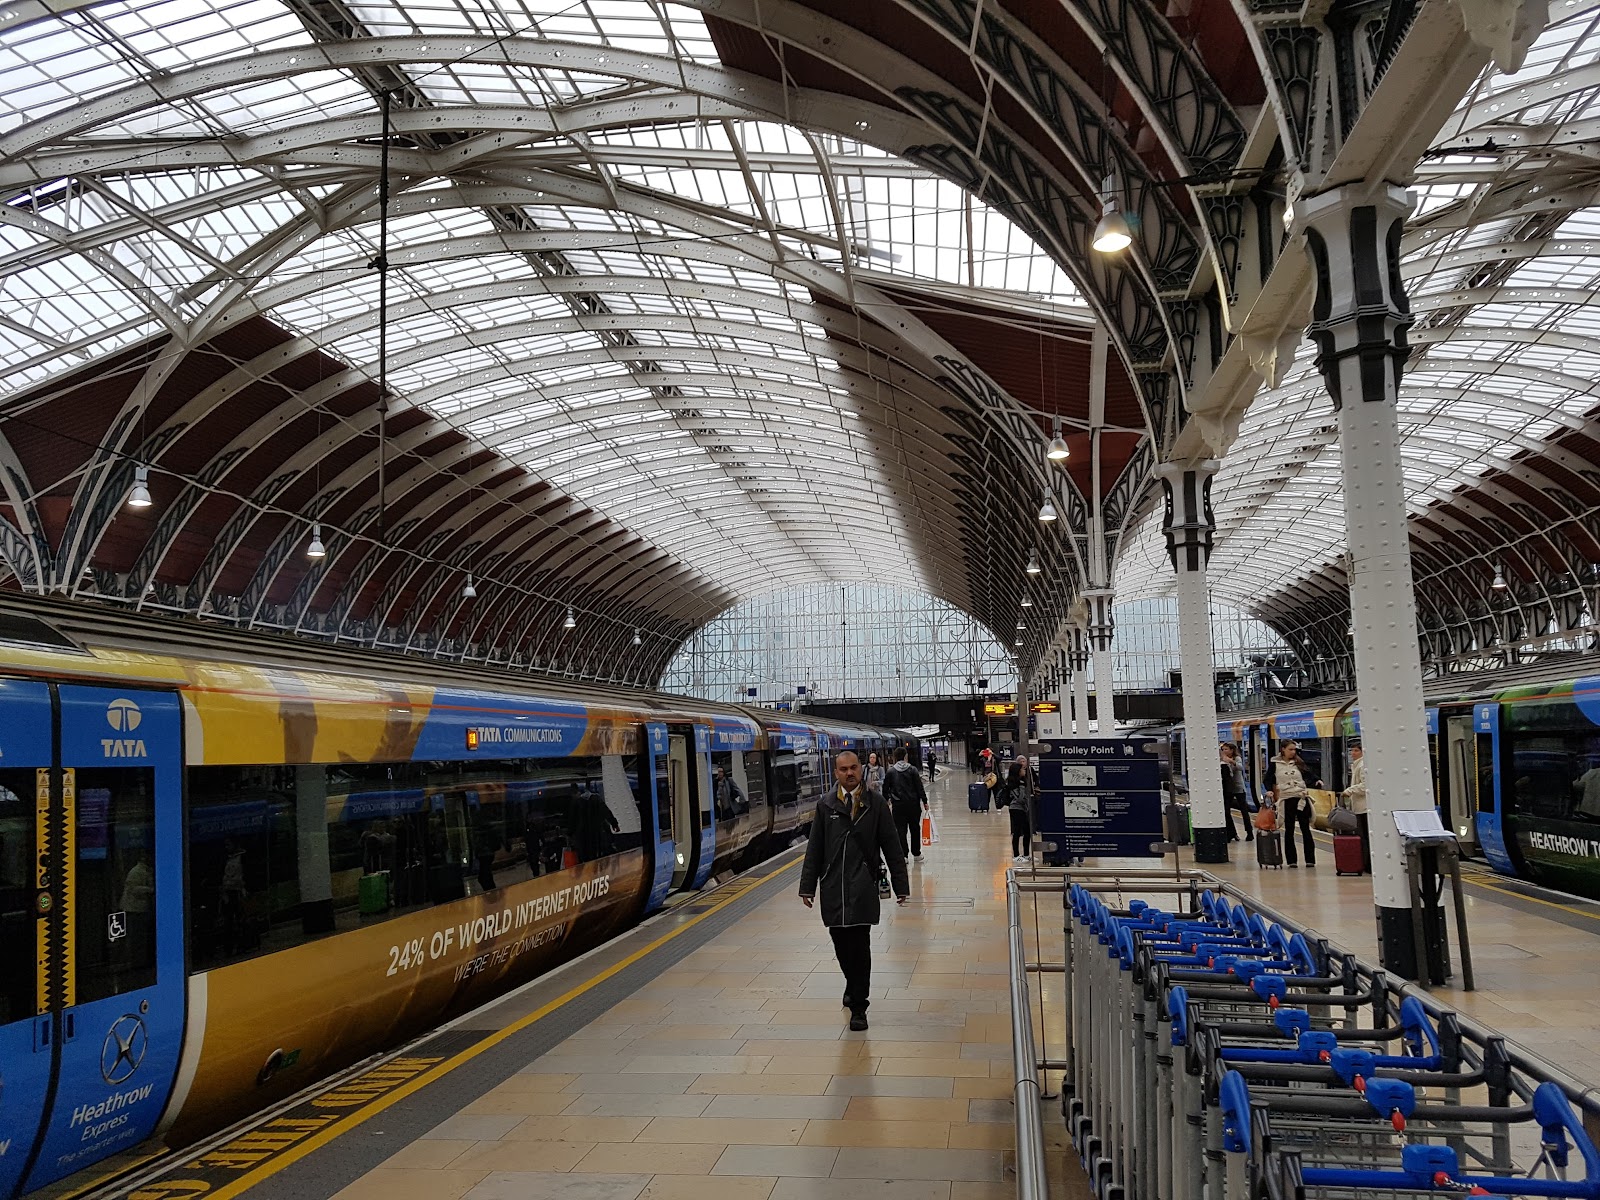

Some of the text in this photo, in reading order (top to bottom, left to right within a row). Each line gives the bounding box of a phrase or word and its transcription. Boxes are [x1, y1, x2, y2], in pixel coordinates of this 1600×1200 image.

[101, 739, 147, 758] TATA
[478, 727, 562, 743] TATA COMMUNICATIONS
[1059, 746, 1114, 756] Trolley Point
[1529, 831, 1589, 857] HEATHROW
[385, 874, 610, 977] 24% OF WORLD INTERNET ROUTES
[453, 922, 567, 984] WE'RE THE CONNECTION
[69, 1083, 154, 1129] Heathrow
[182, 1056, 445, 1169] MIND THE
[81, 1112, 130, 1141] Express
